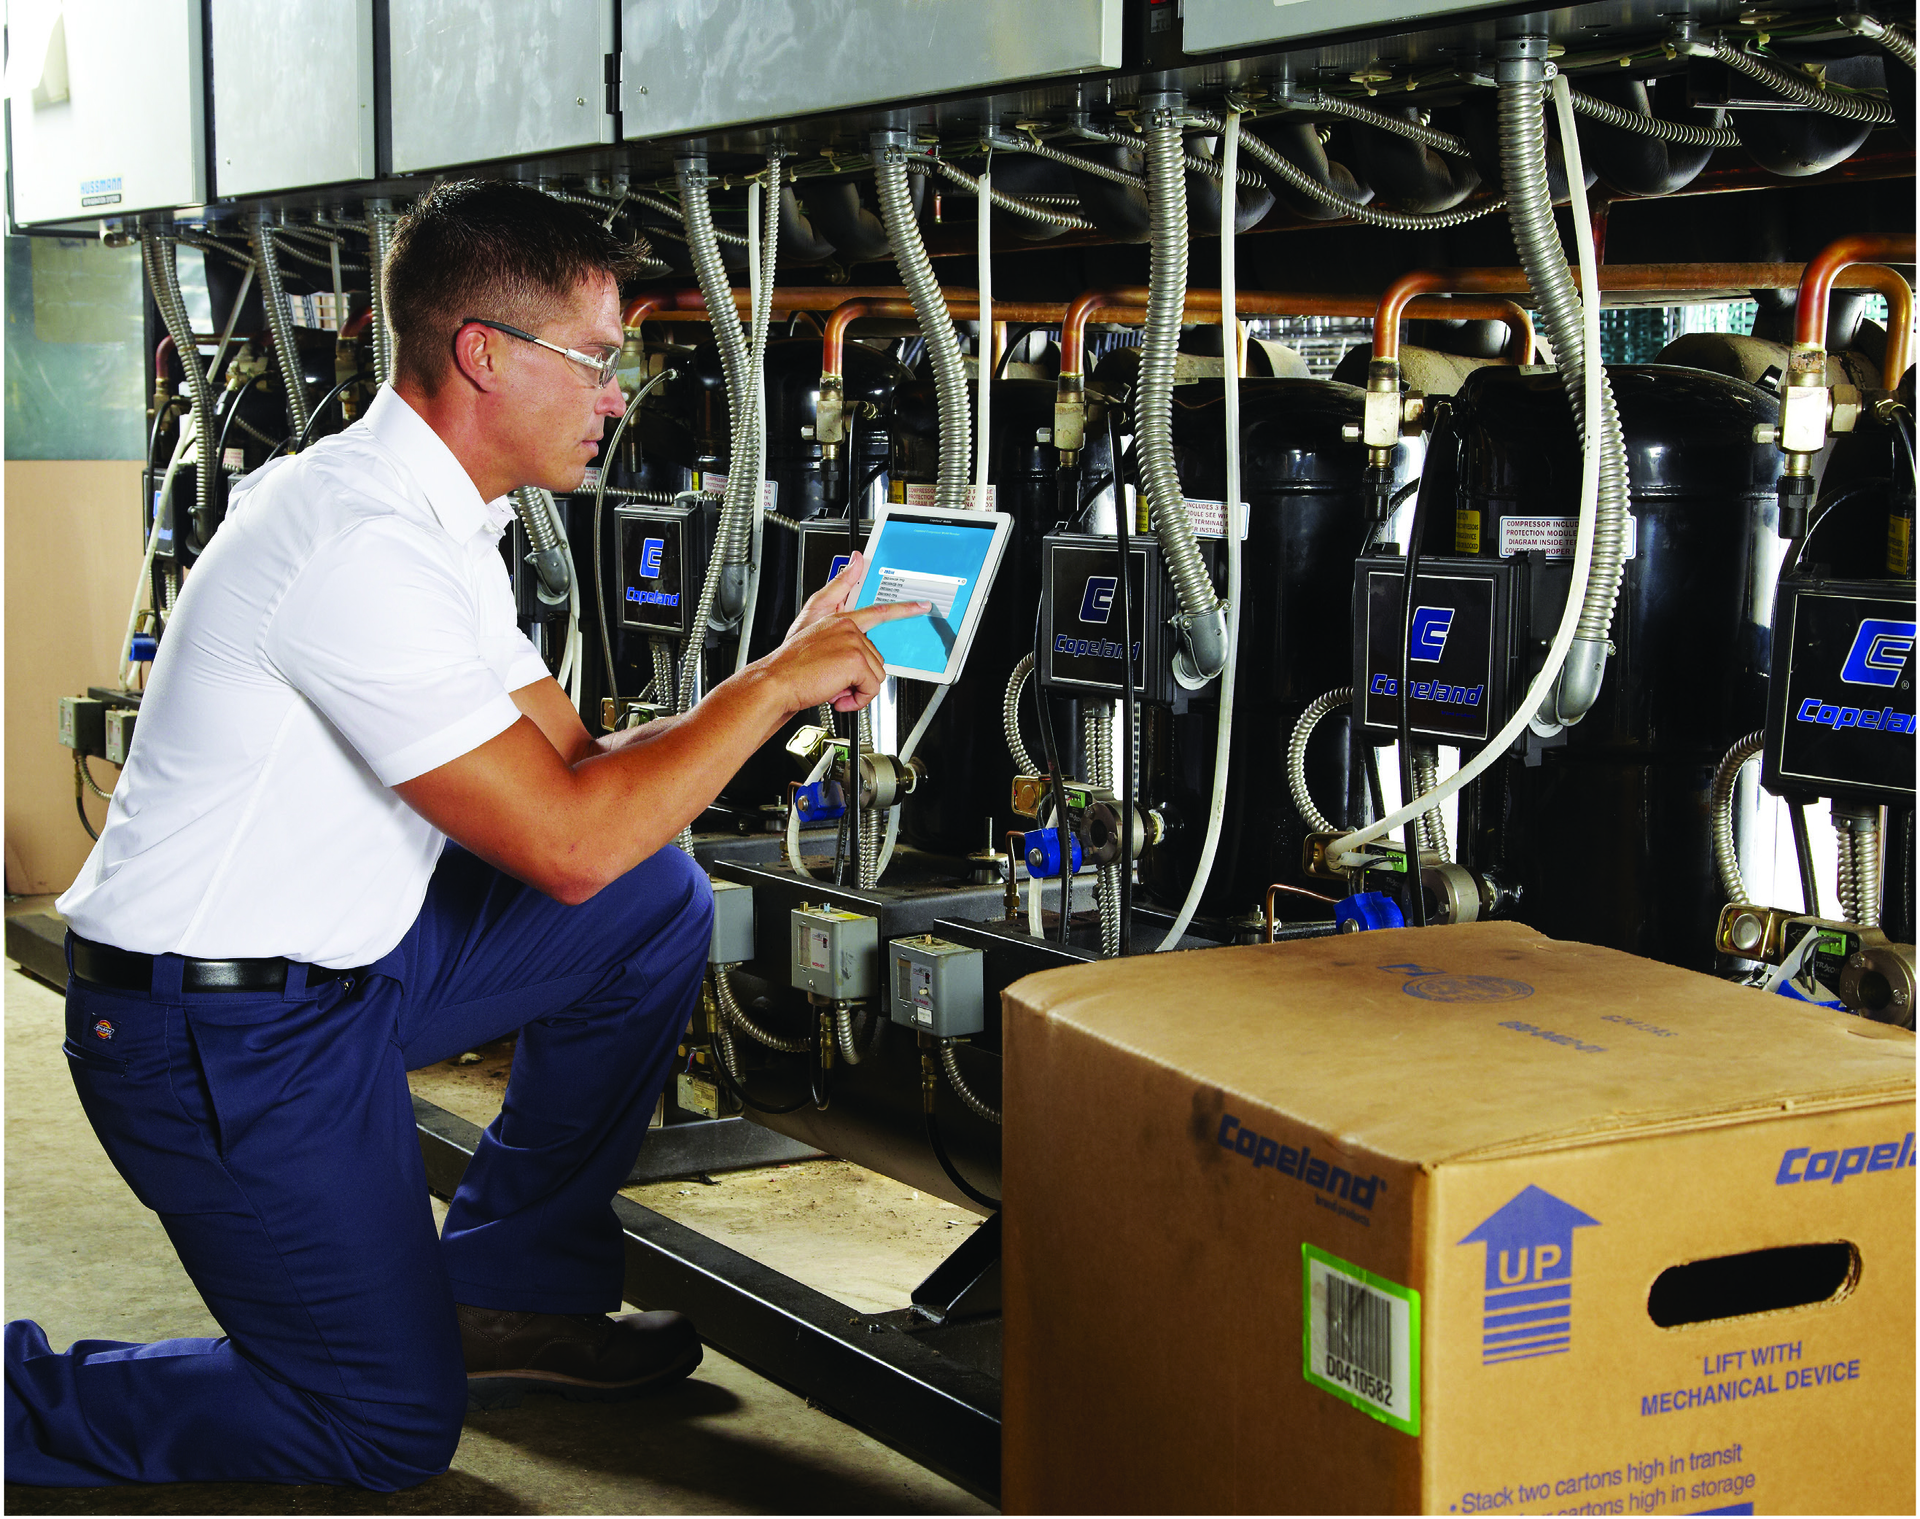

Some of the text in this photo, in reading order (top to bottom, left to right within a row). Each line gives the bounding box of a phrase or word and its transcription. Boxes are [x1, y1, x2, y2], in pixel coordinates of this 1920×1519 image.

[1194, 519, 1223, 527] TERMINAL
[626, 586, 680, 606] Copeland
[1217, 1113, 1379, 1211] Copeland
[1499, 1244, 1562, 1284] UP
[1703, 1341, 1802, 1376] LIFT WITH
[1326, 1354, 1393, 1406] D0410582
[1641, 1359, 1861, 1416] MECHANICAL DEVICE
[1461, 1443, 1743, 1514] Stack two cartons high in transit
[1629, 1488, 1666, 1511] high
[1671, 1484, 1686, 1503] in
[1691, 1473, 1756, 1499] storage
